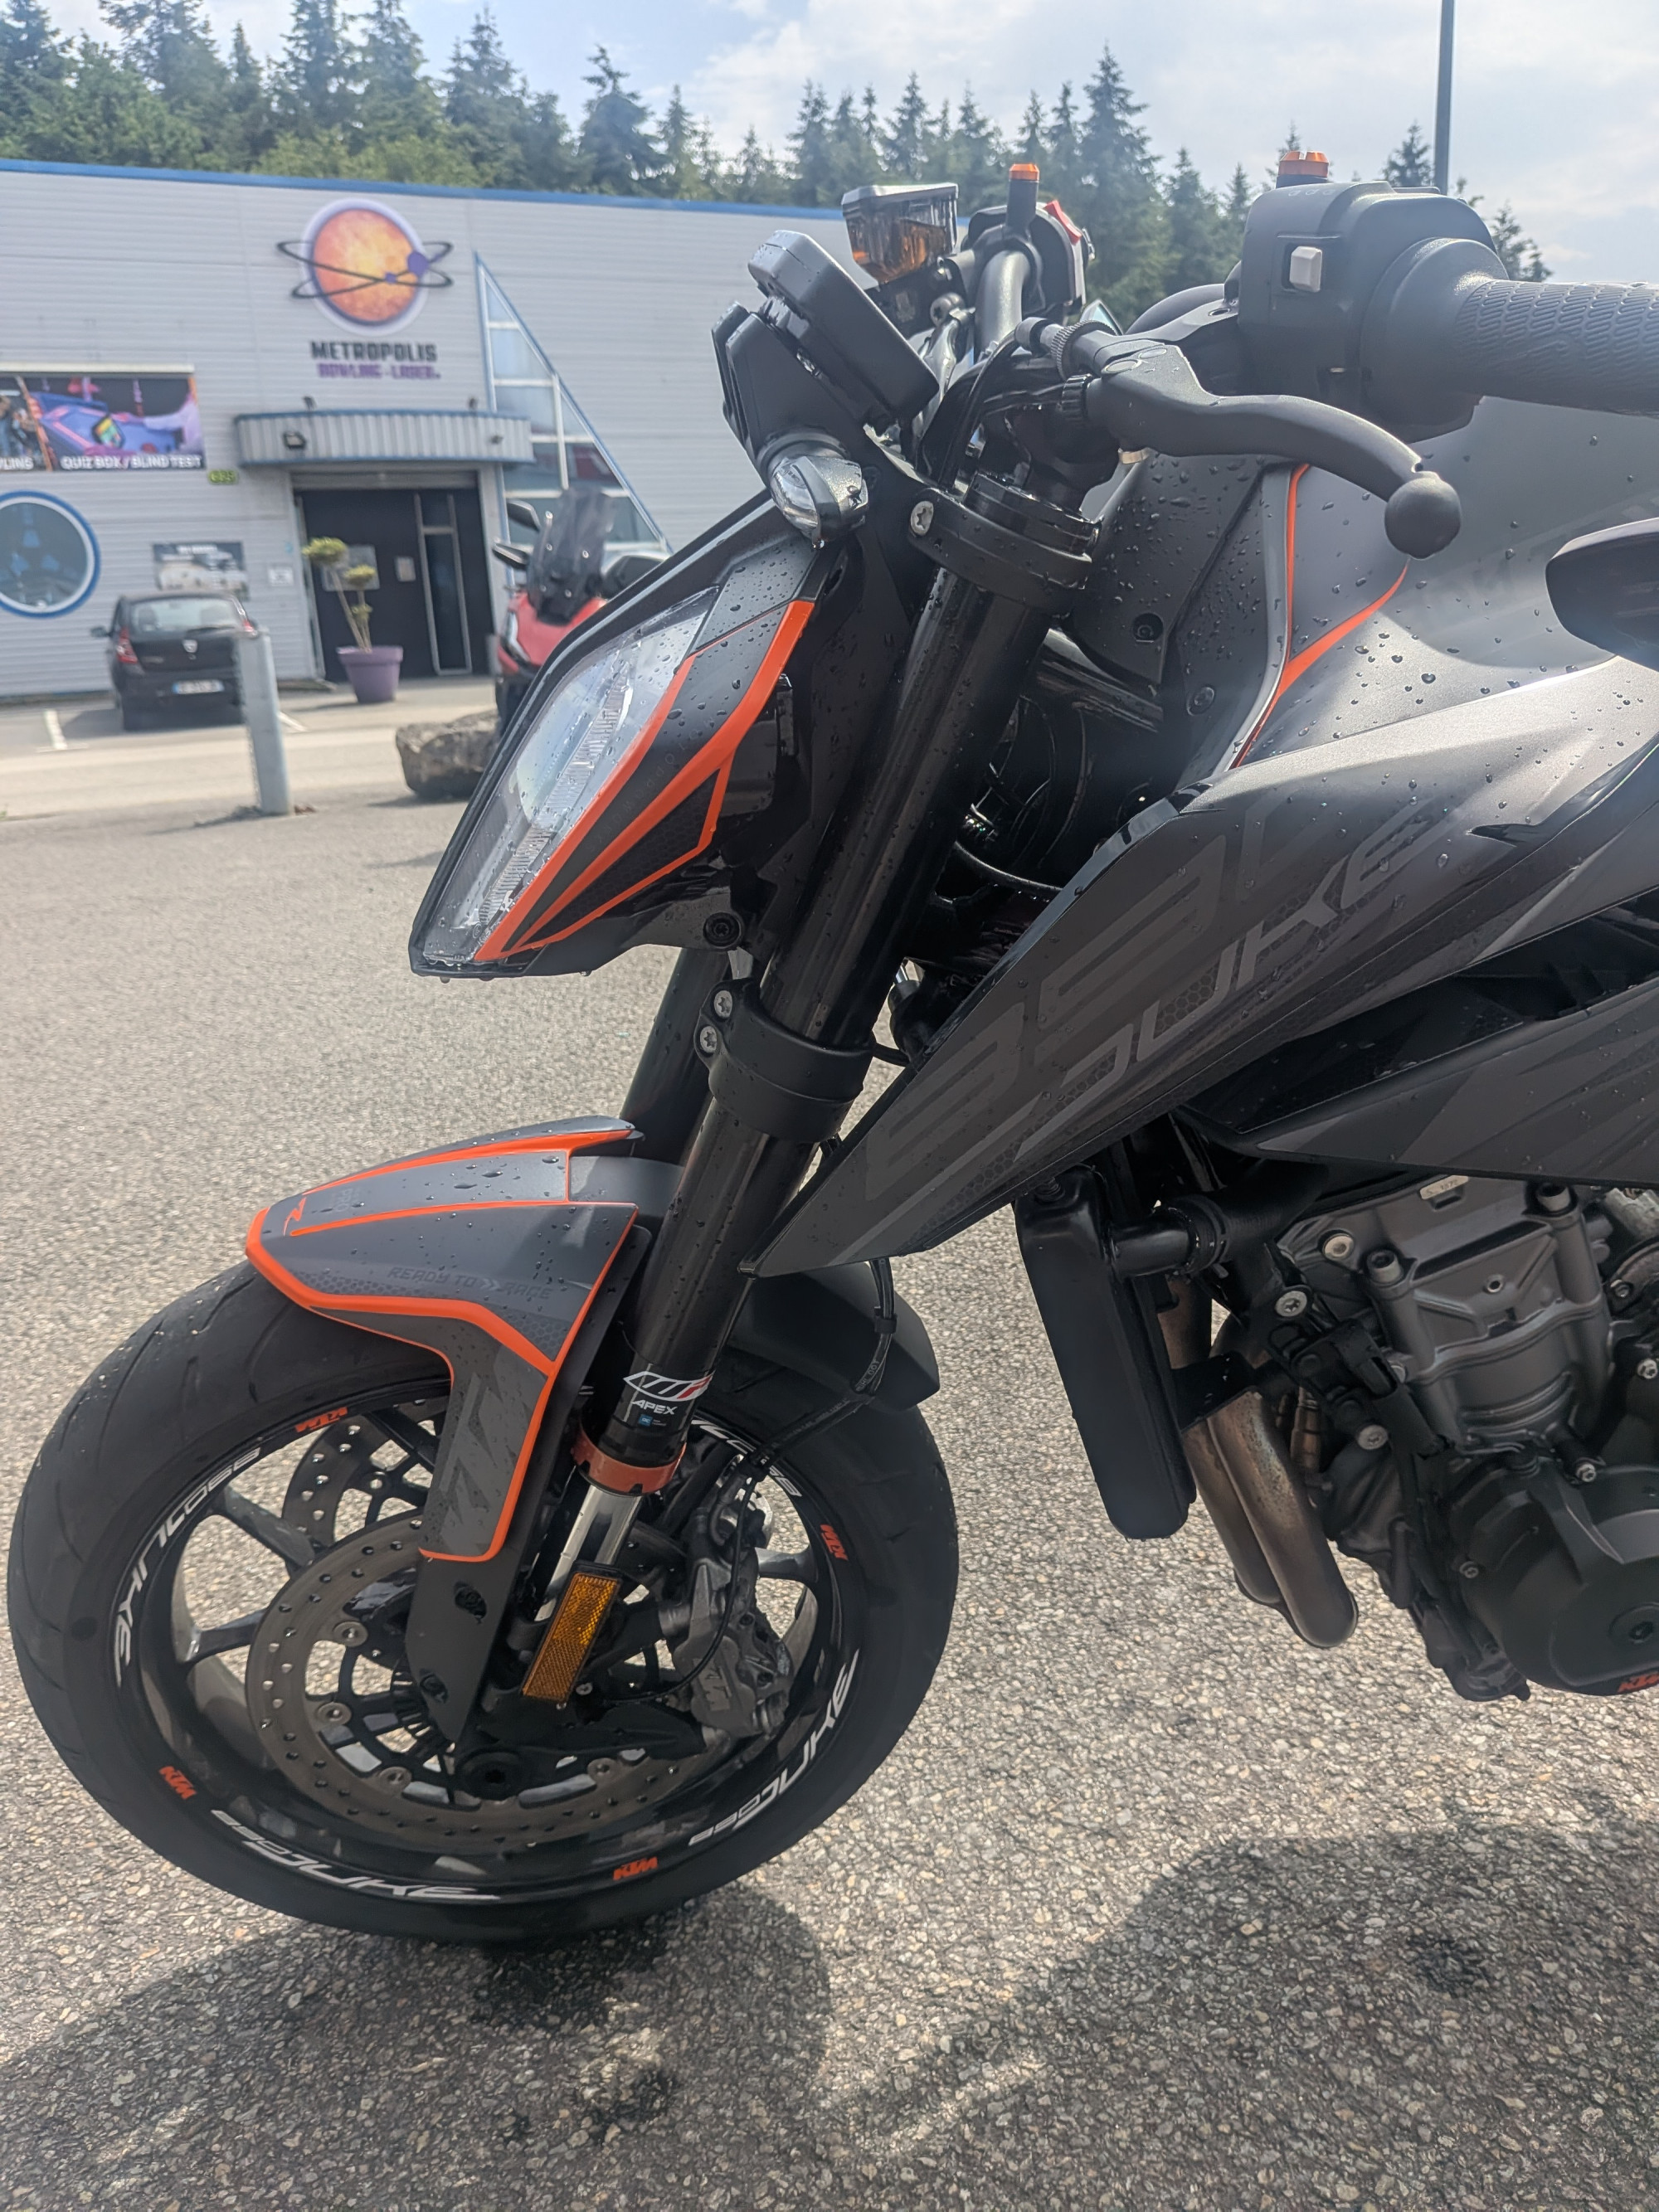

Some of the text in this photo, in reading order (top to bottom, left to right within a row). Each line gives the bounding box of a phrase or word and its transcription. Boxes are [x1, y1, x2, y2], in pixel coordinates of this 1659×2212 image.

[310, 342, 437, 362] METROPOLIS
[61, 456, 94, 470] QUIZ
[95, 456, 123, 469] BOX
[131, 456, 169, 469] BLIND
[171, 456, 202, 469] TEST
[1014, 792, 1447, 1161] DUKE
[387, 1266, 451, 1285] READY
[455, 1273, 478, 1287] TO
[631, 1399, 678, 1415] APEX
[158, 1766, 198, 1801] KTM
[613, 1857, 658, 1881] KTM
